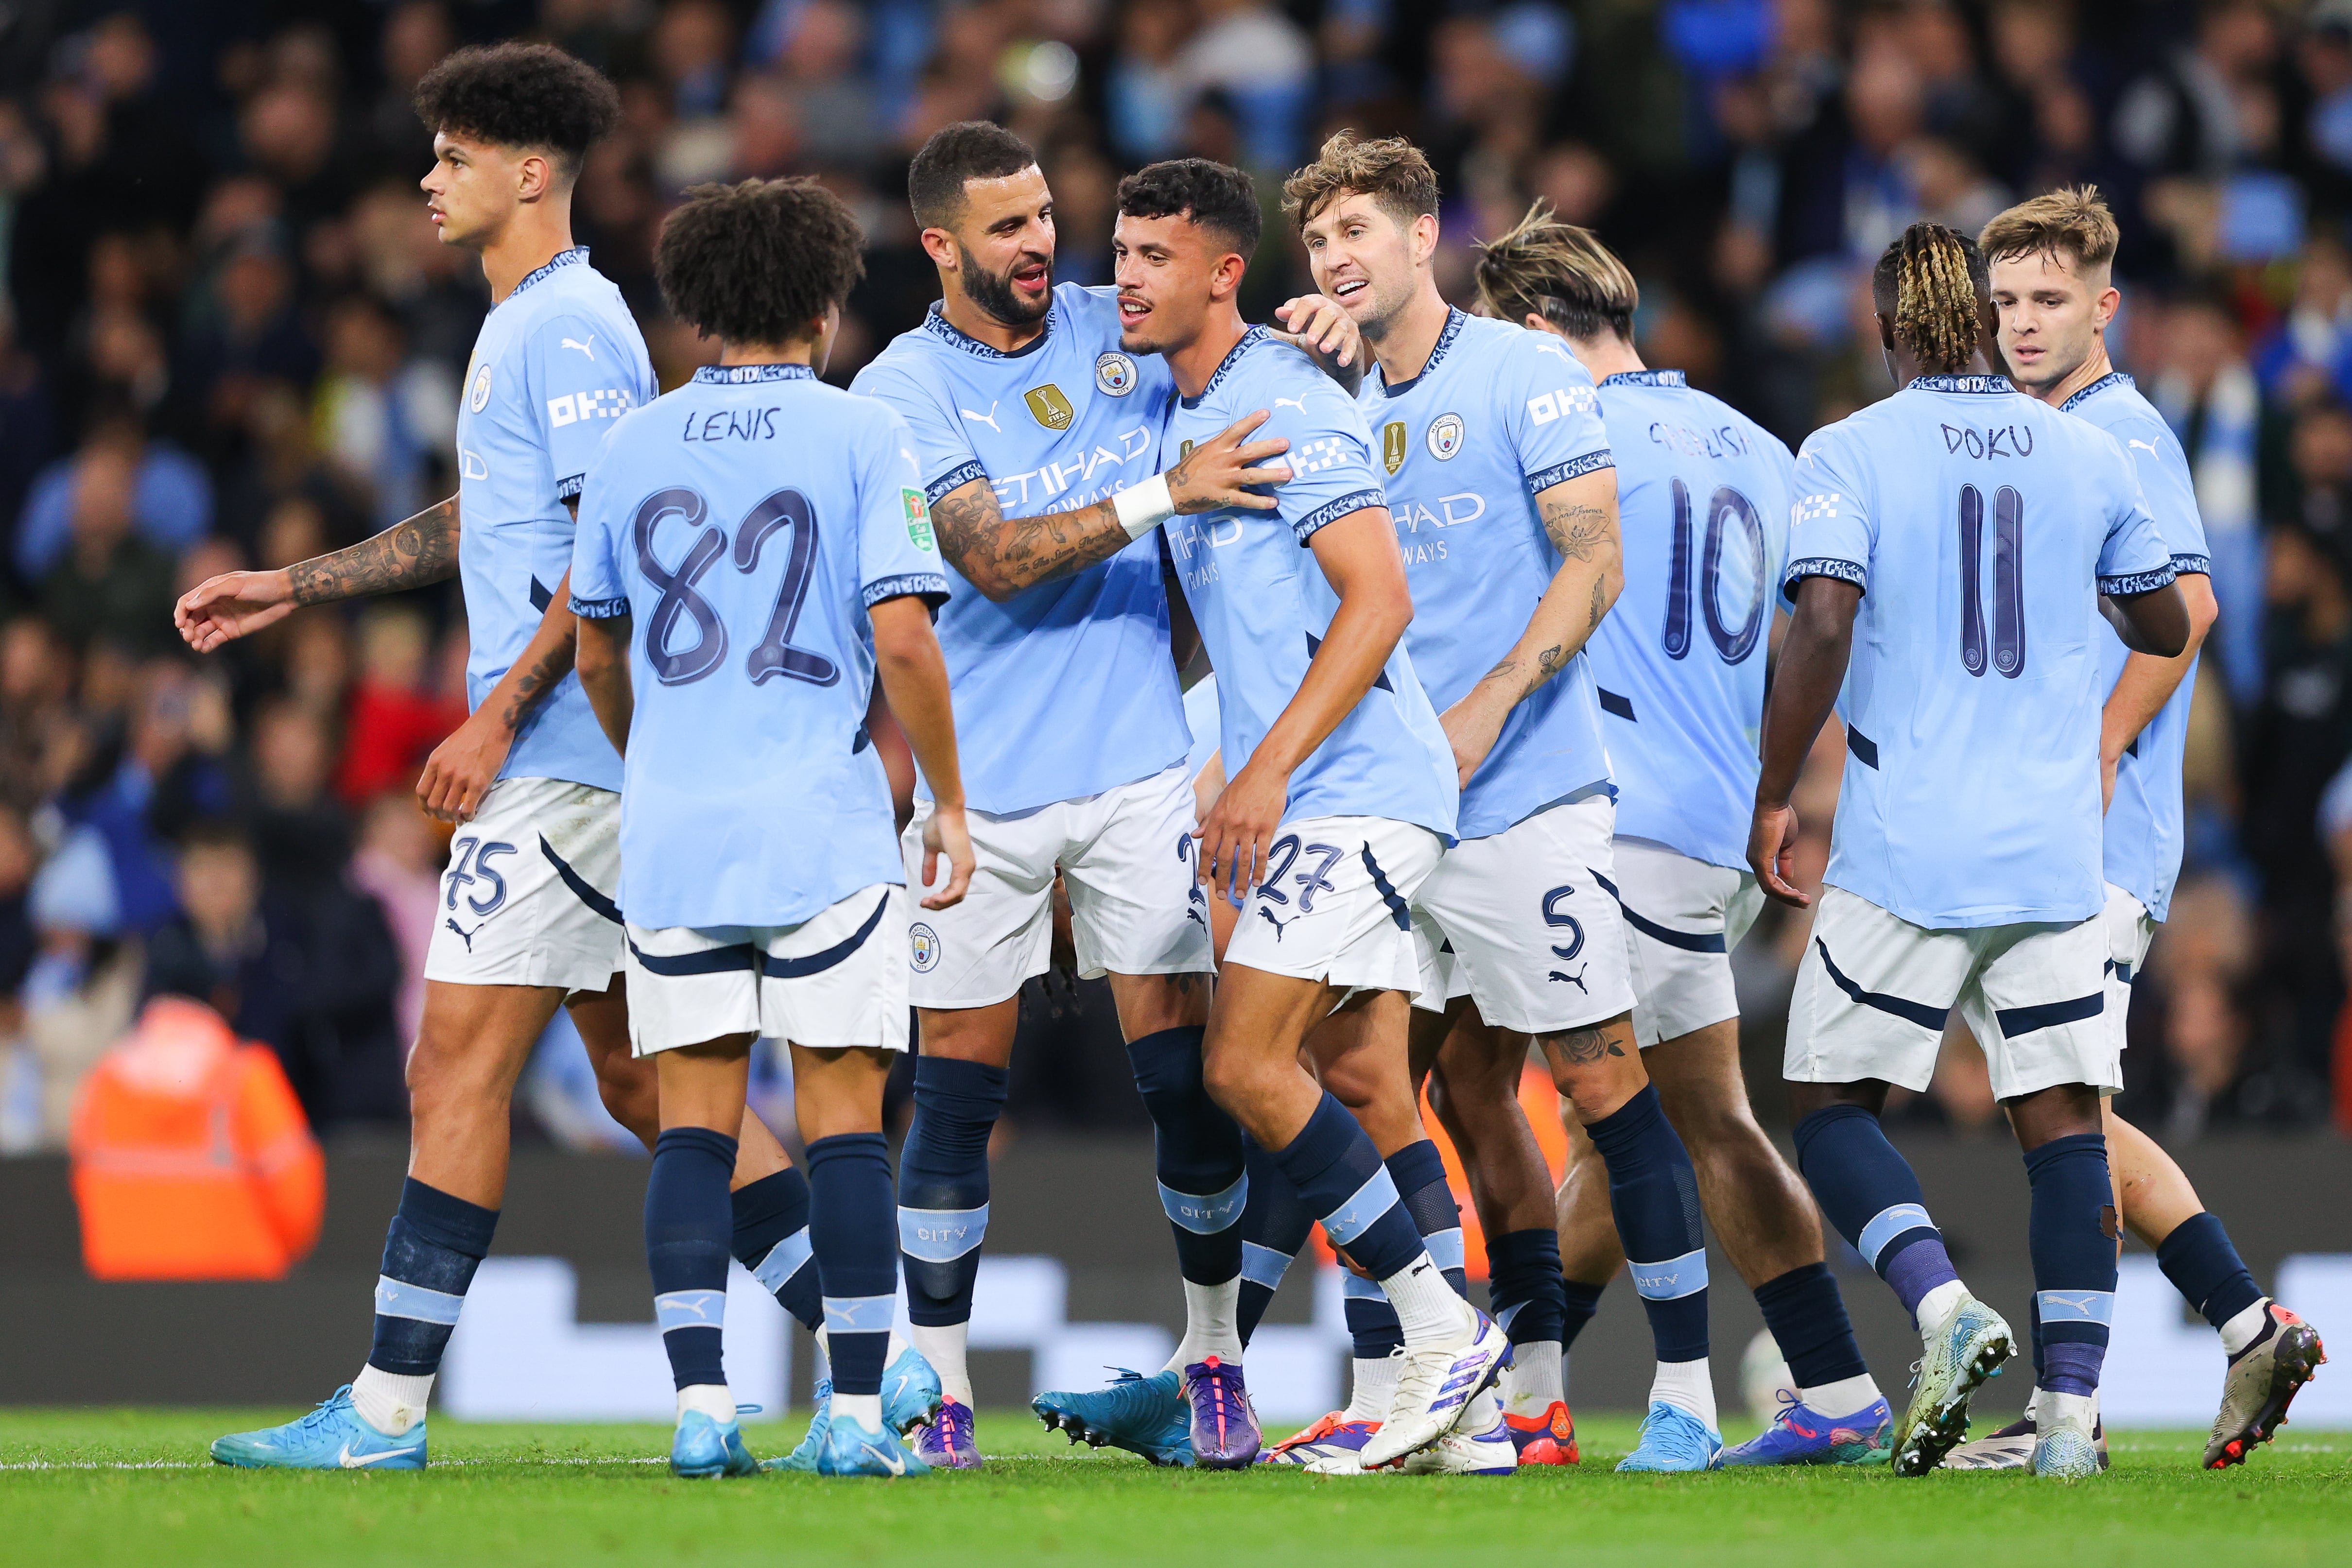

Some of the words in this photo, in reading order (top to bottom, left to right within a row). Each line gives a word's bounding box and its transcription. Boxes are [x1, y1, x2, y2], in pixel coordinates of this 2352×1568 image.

[1096, 355, 1126, 374] MANCHESTER
[1958, 378, 1986, 390] CITY
[684, 407, 781, 442] LEWIS
[1048, 412, 1067, 423] FIFA
[1431, 416, 1462, 434] MANCHESTER
[1940, 423, 2033, 461] DOKU
[989, 424, 1151, 509] ETIHAD
[1388, 455, 1400, 464] FIFA
[1024, 479, 1125, 519] RWAYS
[1388, 492, 1486, 537] HAD
[1167, 515, 1244, 565] TIHAD
[1399, 540, 1448, 566] WAYS
[1184, 562, 1219, 591] IRWAYS
[1661, 476, 1766, 666] 10
[1958, 483, 2026, 679] 11
[632, 486, 842, 688] 82
[447, 837, 518, 916] 75
[1256, 832, 1345, 913] 27
[910, 926, 936, 944] MANCHESTER
[1540, 884, 1585, 961] 5
[1180, 1200, 1234, 1220] CITY
[1328, 1212, 1357, 1235] ITY
[917, 1225, 968, 1242] CITY
[1637, 1273, 1679, 1288] CITY
[1442, 1438, 1462, 1450] COPA
